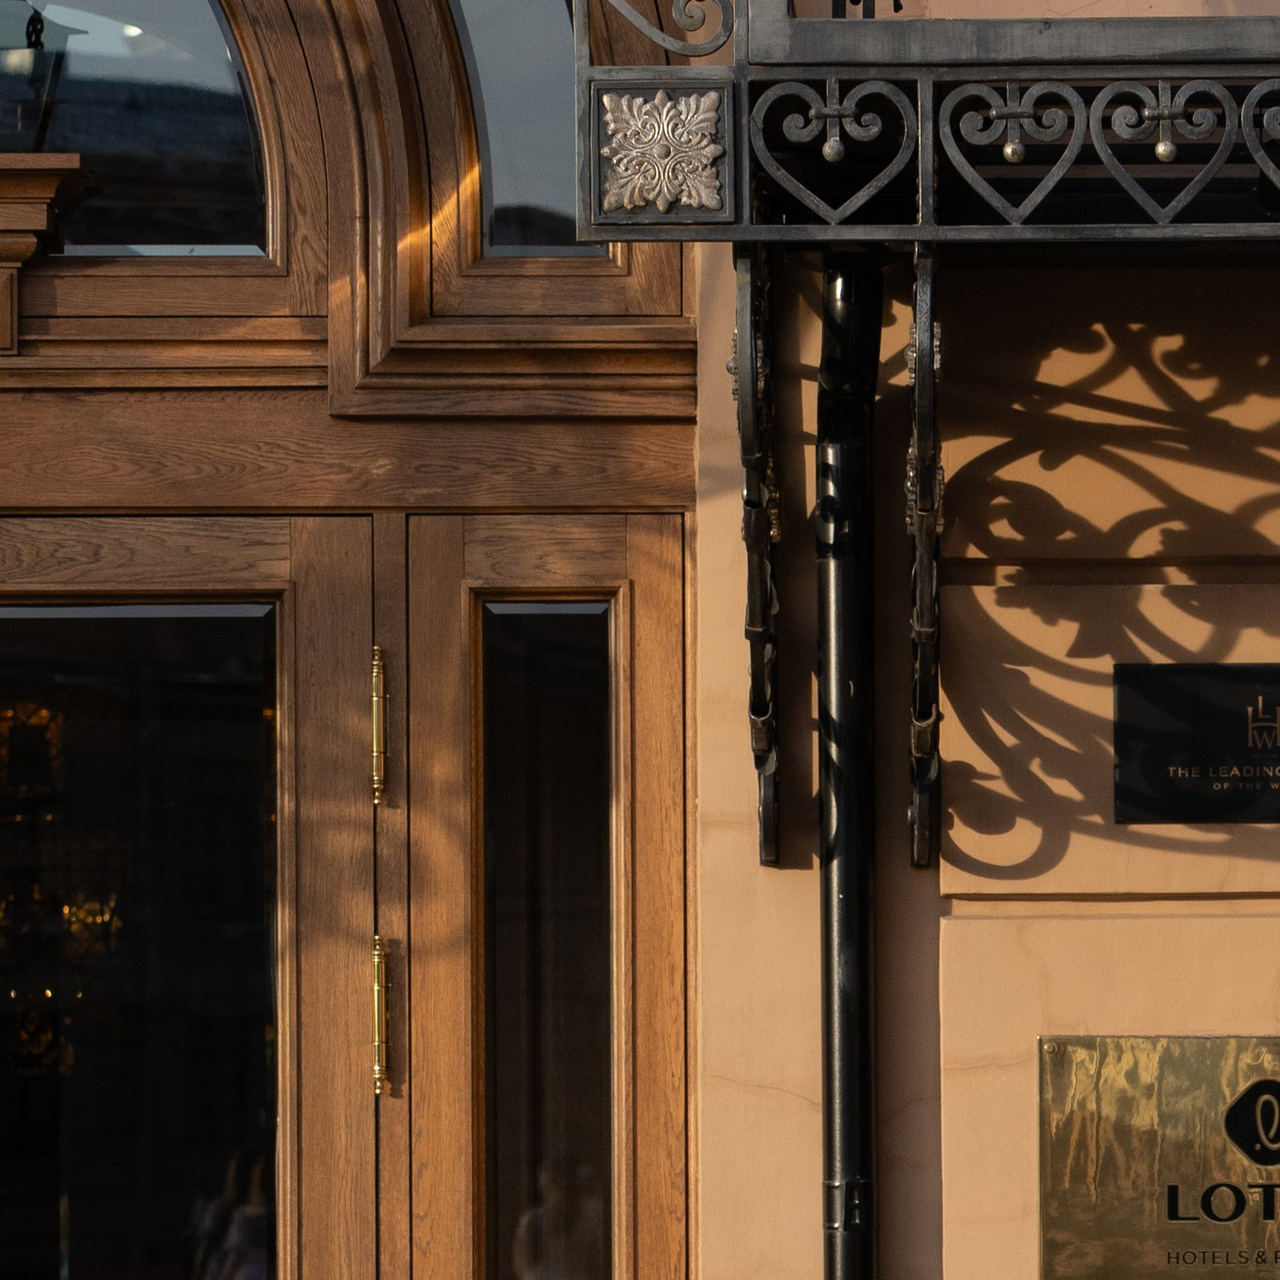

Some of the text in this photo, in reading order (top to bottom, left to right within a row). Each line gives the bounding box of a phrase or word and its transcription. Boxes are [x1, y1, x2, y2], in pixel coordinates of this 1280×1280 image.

[1167, 766, 1200, 778] THE
[1213, 782, 1230, 790] OF
[1238, 782, 1262, 790] THE
[1167, 1250, 1249, 1265] HOTELS
[1255, 1250, 1267, 1264] &
